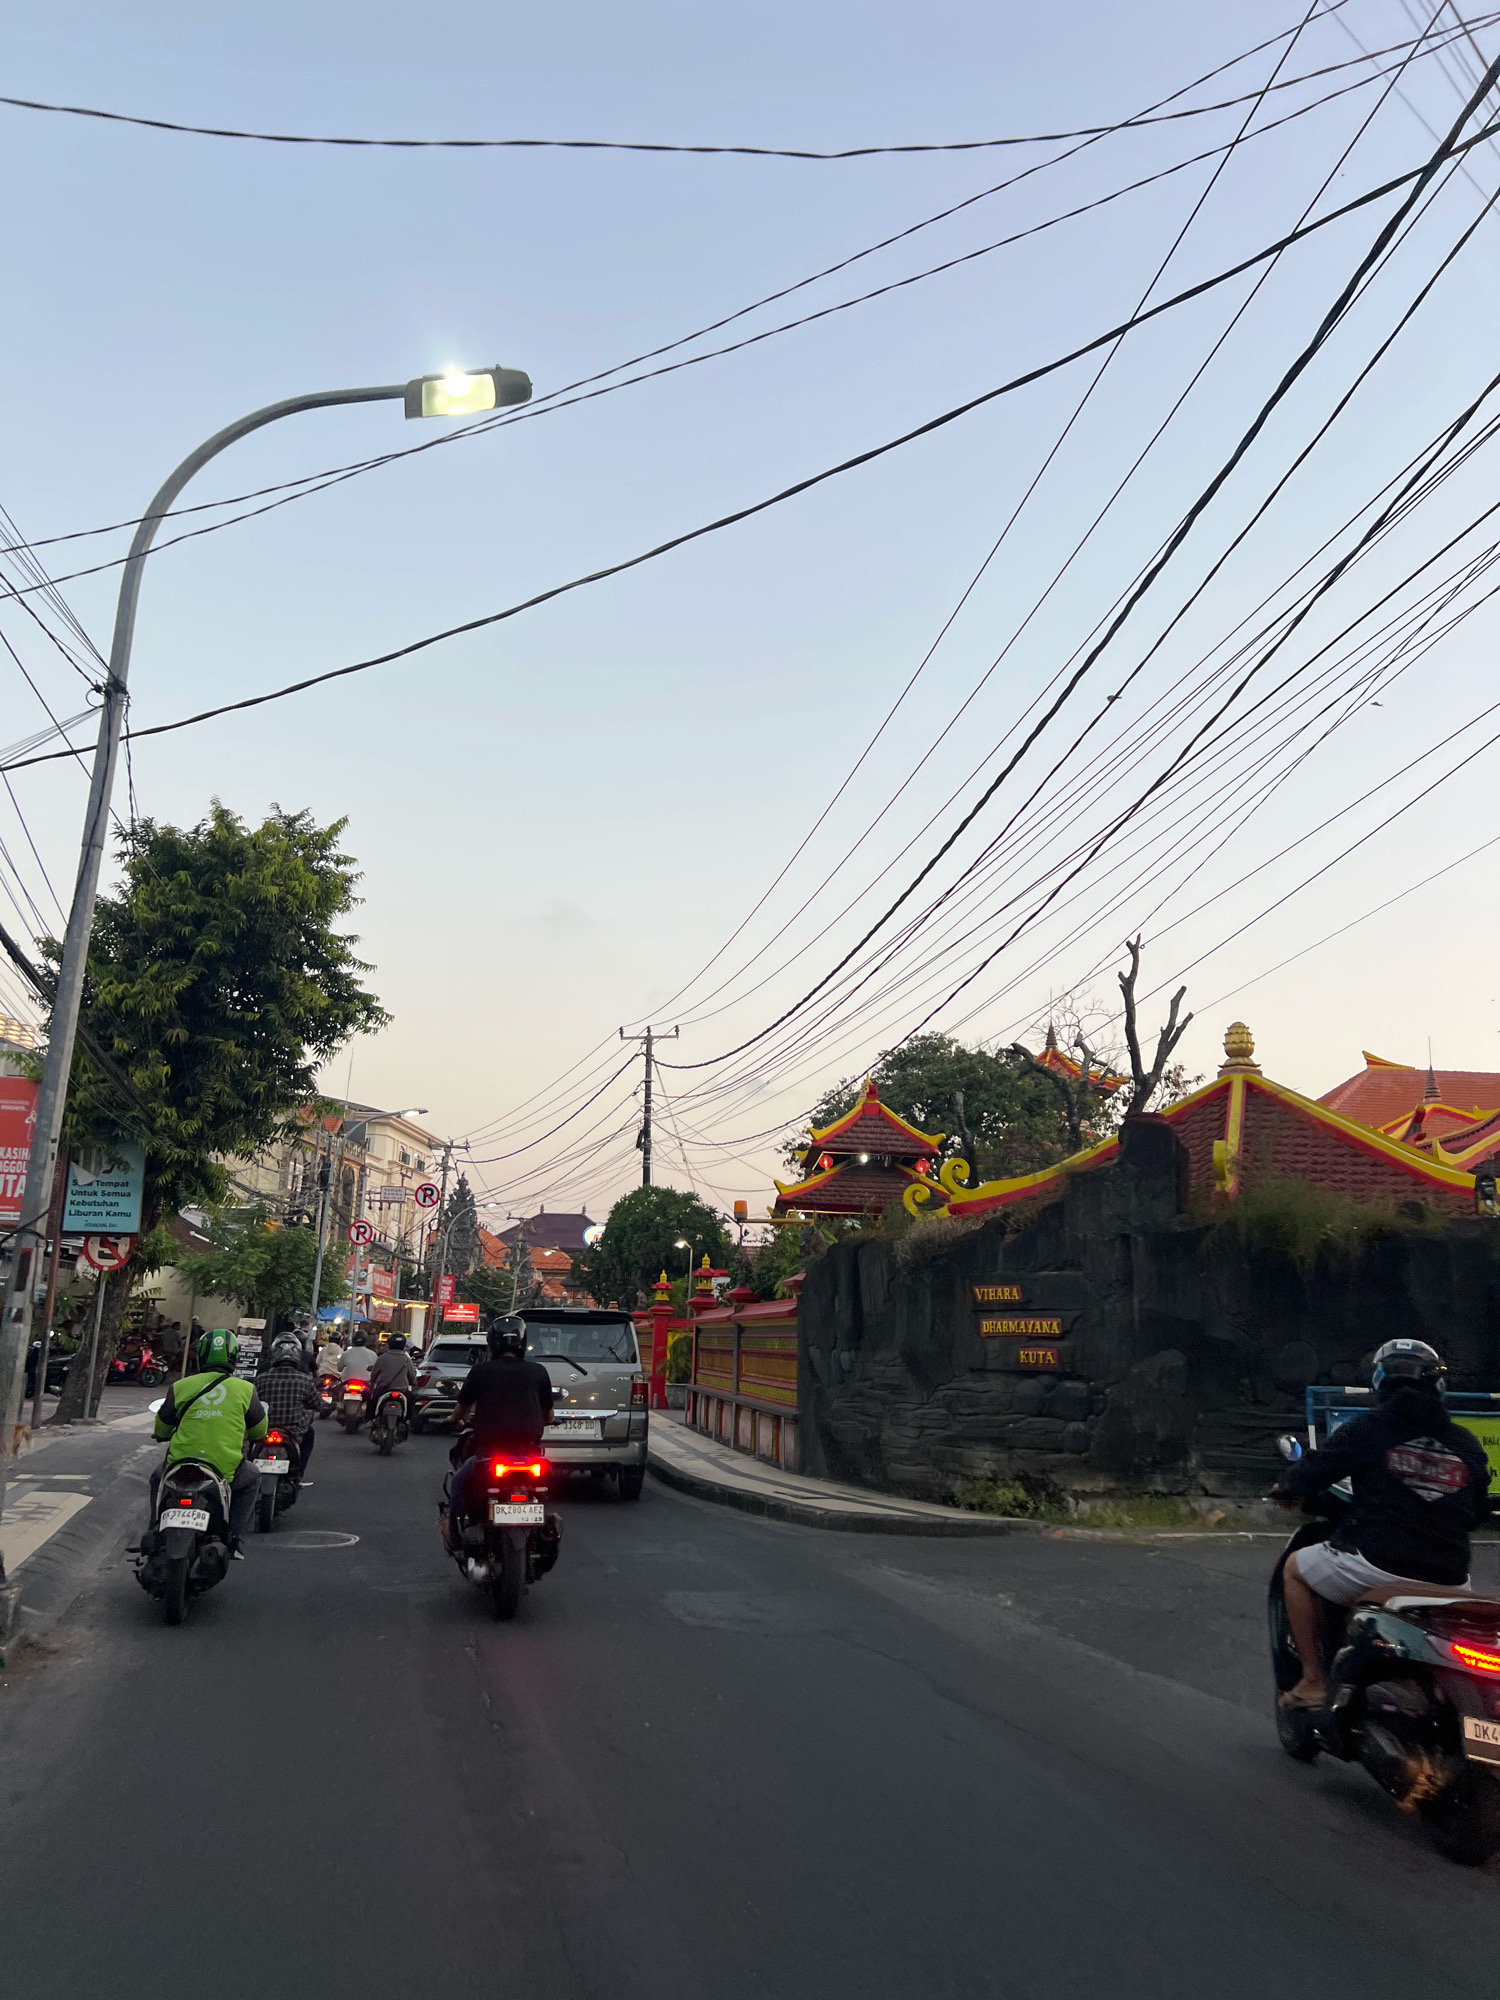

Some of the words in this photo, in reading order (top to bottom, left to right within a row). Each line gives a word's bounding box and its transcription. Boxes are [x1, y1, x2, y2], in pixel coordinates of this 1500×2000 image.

[96, 1180, 129, 1188] Tempat
[975, 1287, 1020, 1300] VIHARA
[982, 1320, 1060, 1334] DHARMAYANA
[1020, 1350, 1056, 1364] KUTA
[196, 1408, 223, 1418] gojek
[496, 1506, 507, 1515] DK
[1474, 1723, 1490, 1740] DK
